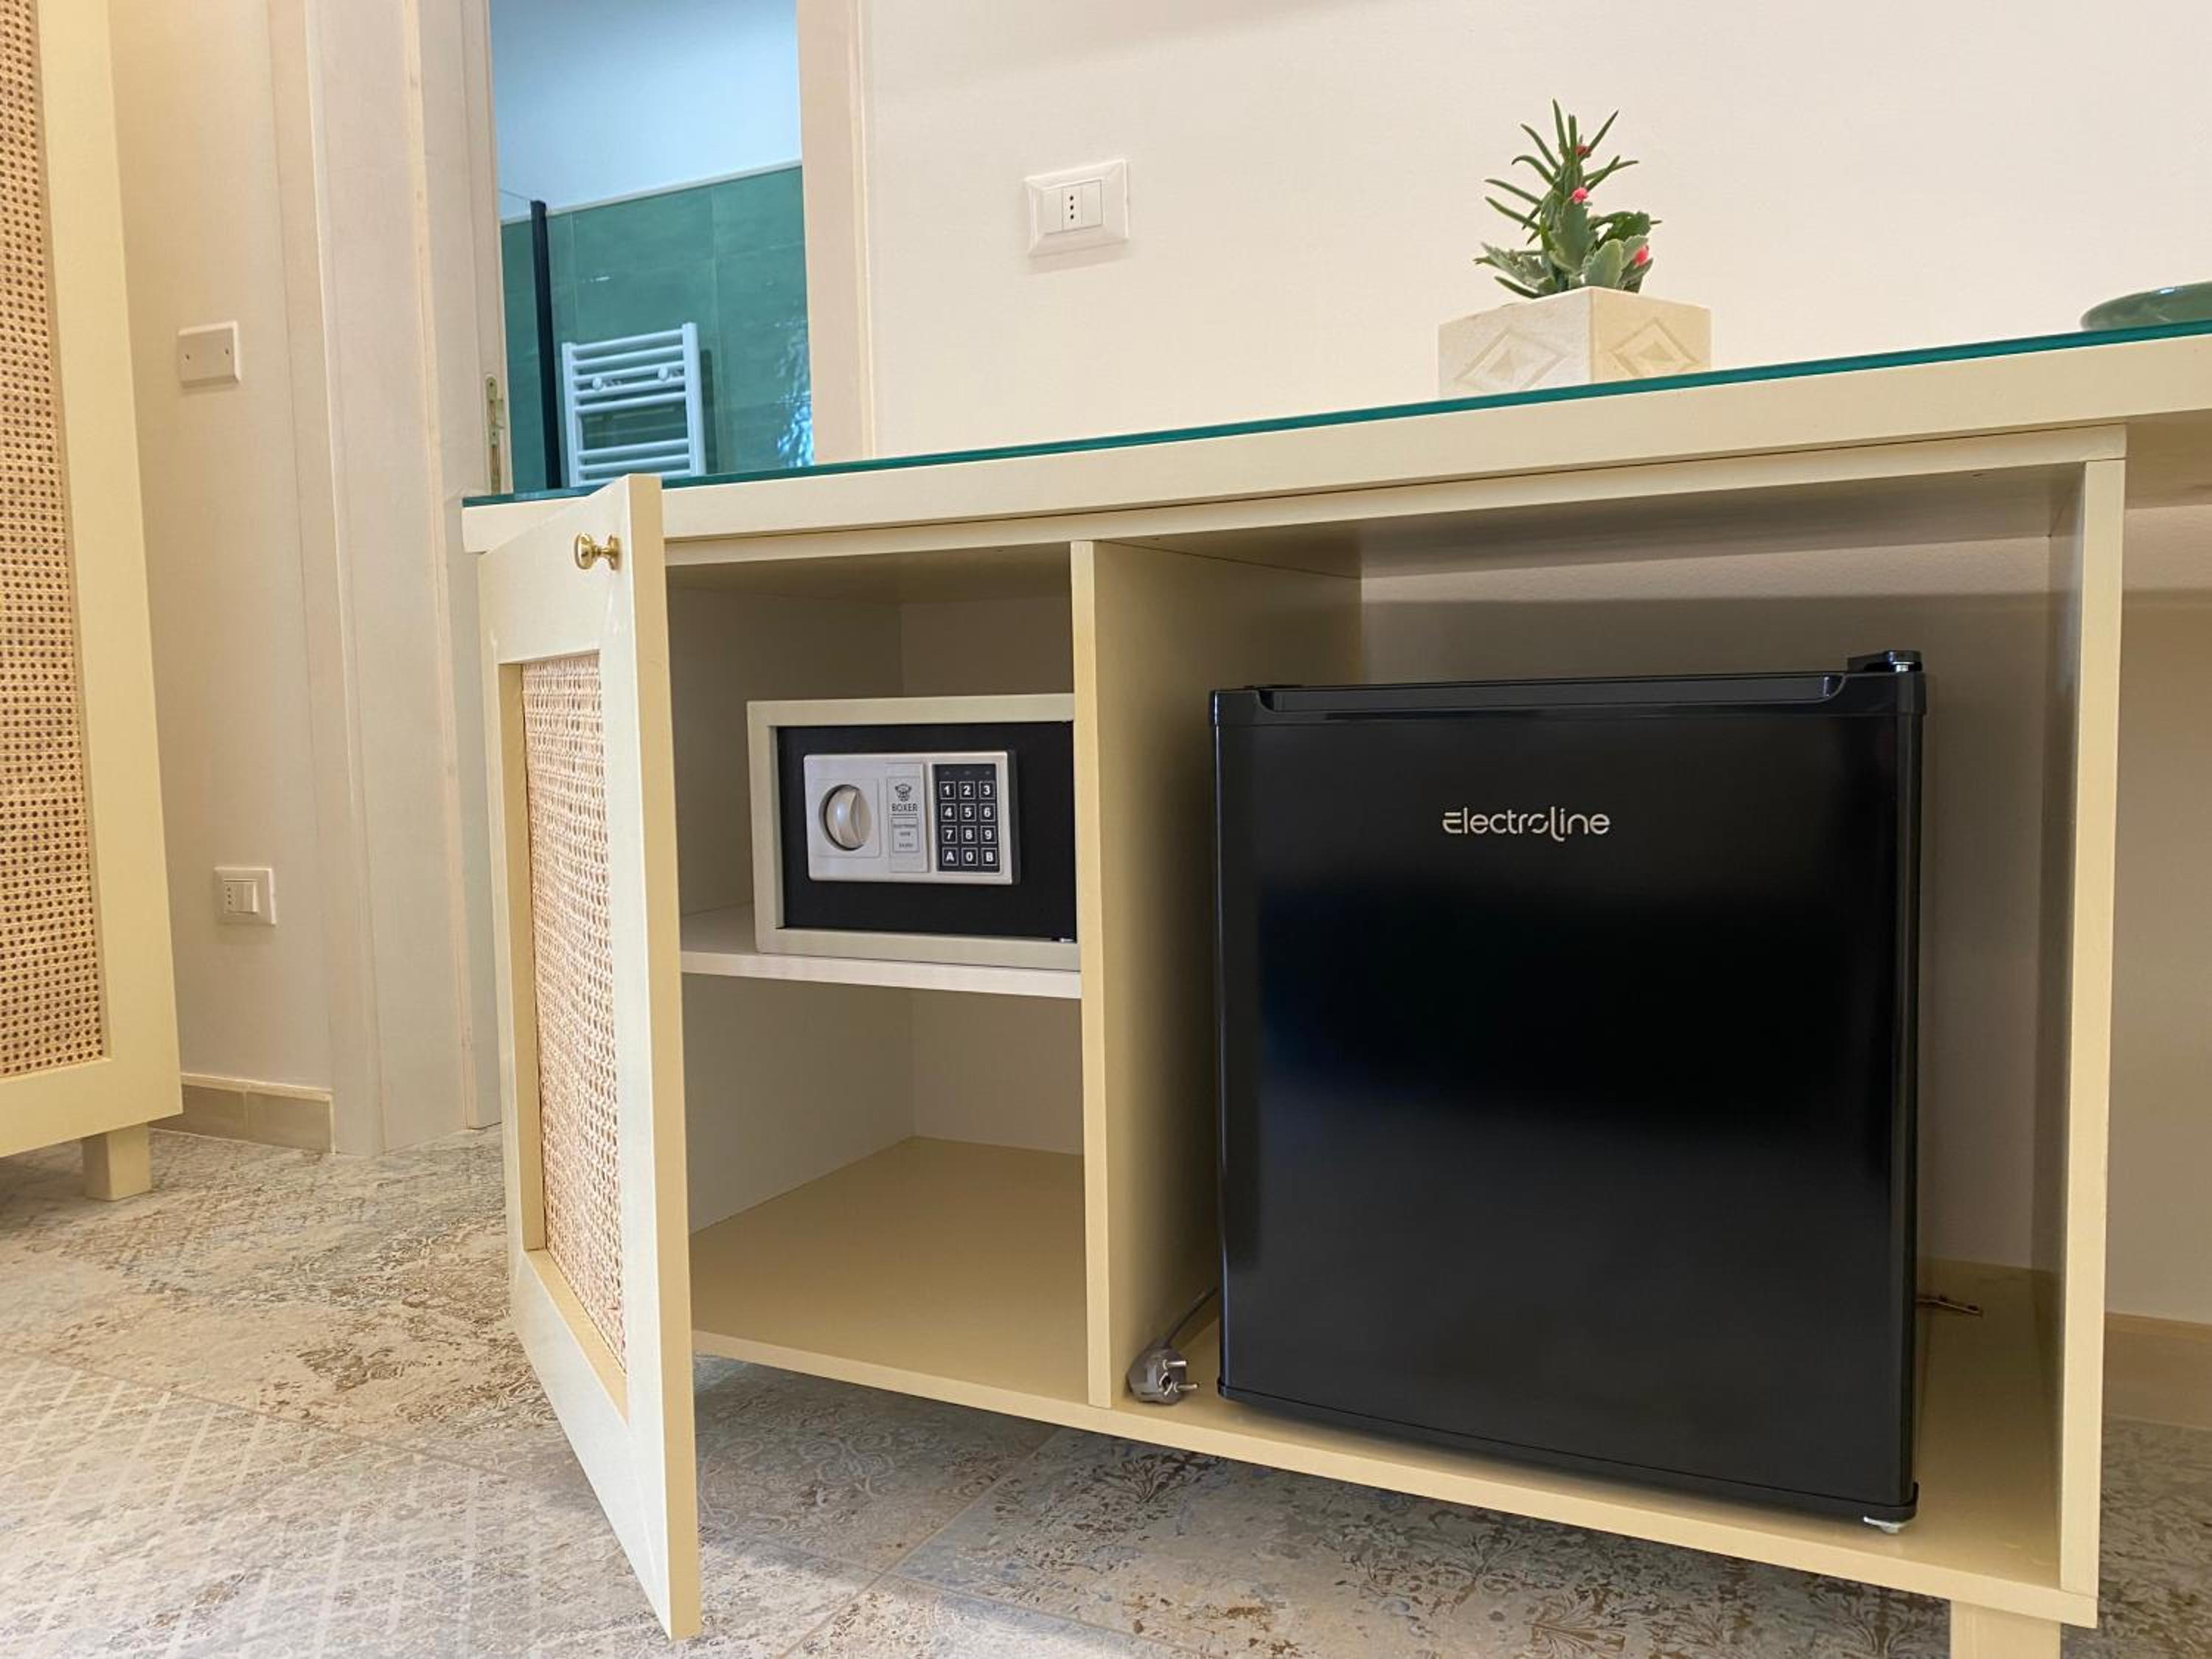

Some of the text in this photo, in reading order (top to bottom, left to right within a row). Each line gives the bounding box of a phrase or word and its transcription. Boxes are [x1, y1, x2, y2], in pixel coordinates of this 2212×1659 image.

[944, 785, 990, 795] 1 2 3
[891, 803, 918, 812] BOXER
[945, 807, 991, 818] 4 5 6
[1442, 806, 1610, 842] Electroline
[945, 830, 992, 840] 7 8 9
[945, 852, 993, 862] A 0 B
